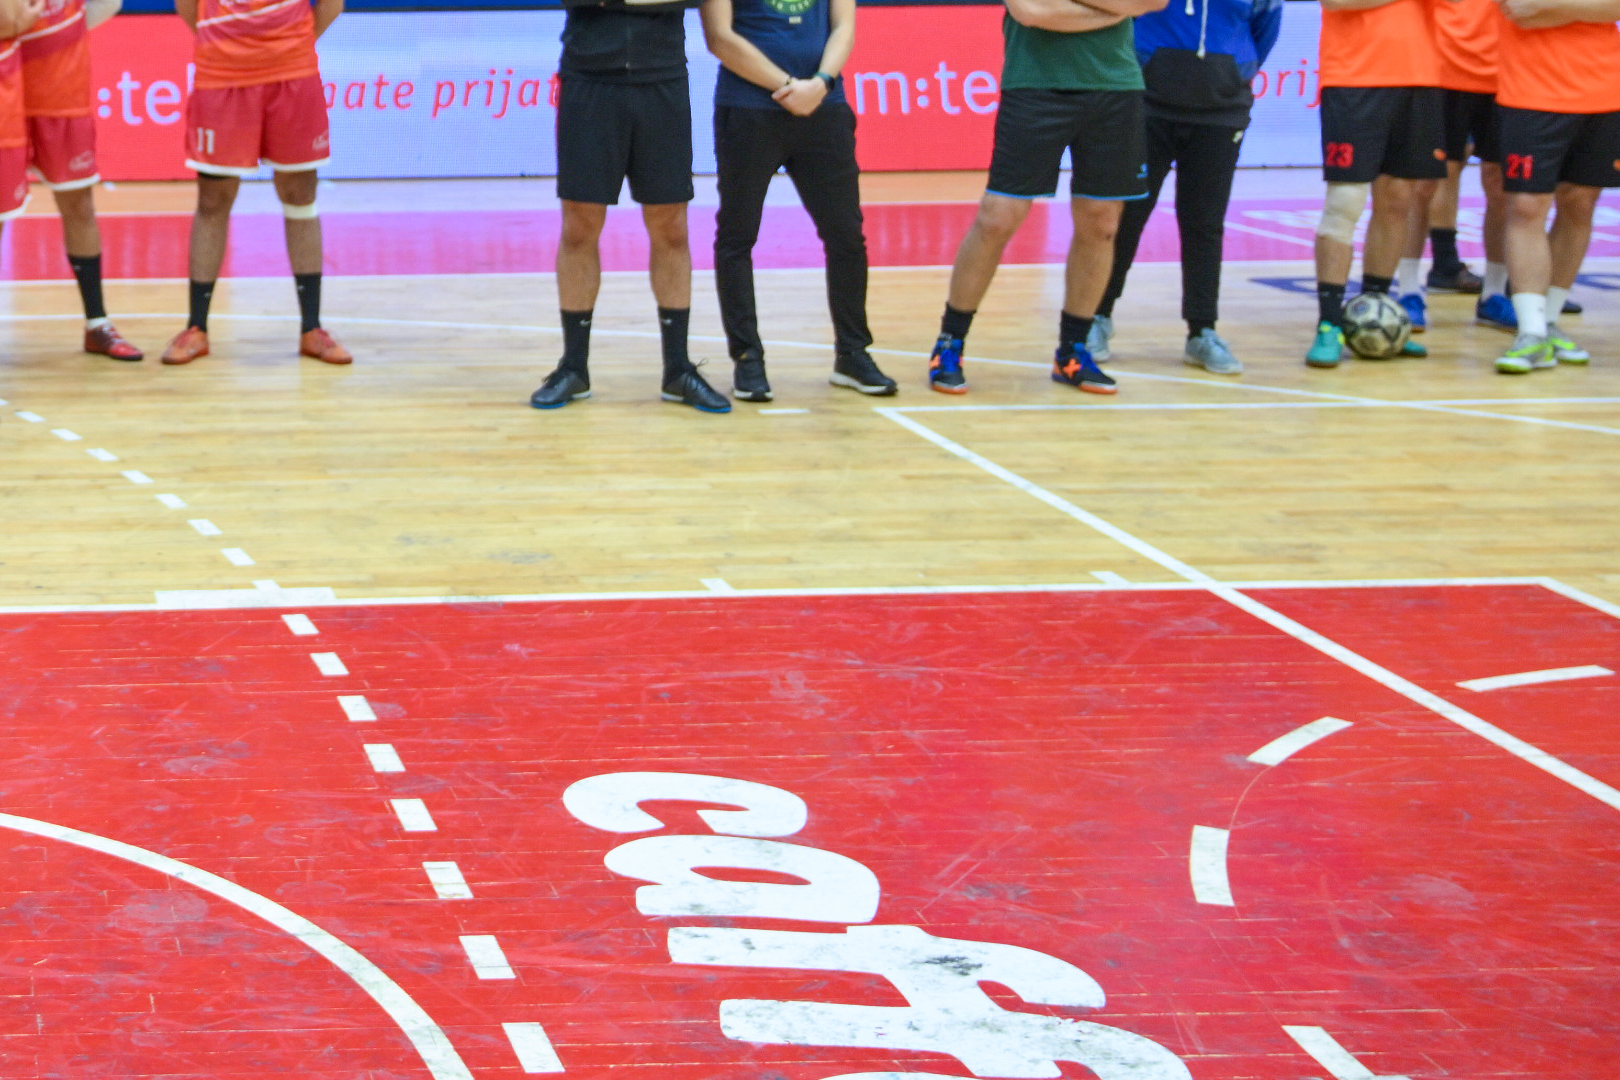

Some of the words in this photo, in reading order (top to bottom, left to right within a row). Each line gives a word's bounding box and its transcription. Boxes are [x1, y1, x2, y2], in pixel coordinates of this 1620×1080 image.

[97, 62, 196, 125] :tel
[854, 61, 999, 115] m:te
[1326, 142, 1355, 168] 23
[1506, 154, 1534, 179] 21
[562, 771, 1195, 1080] caff
